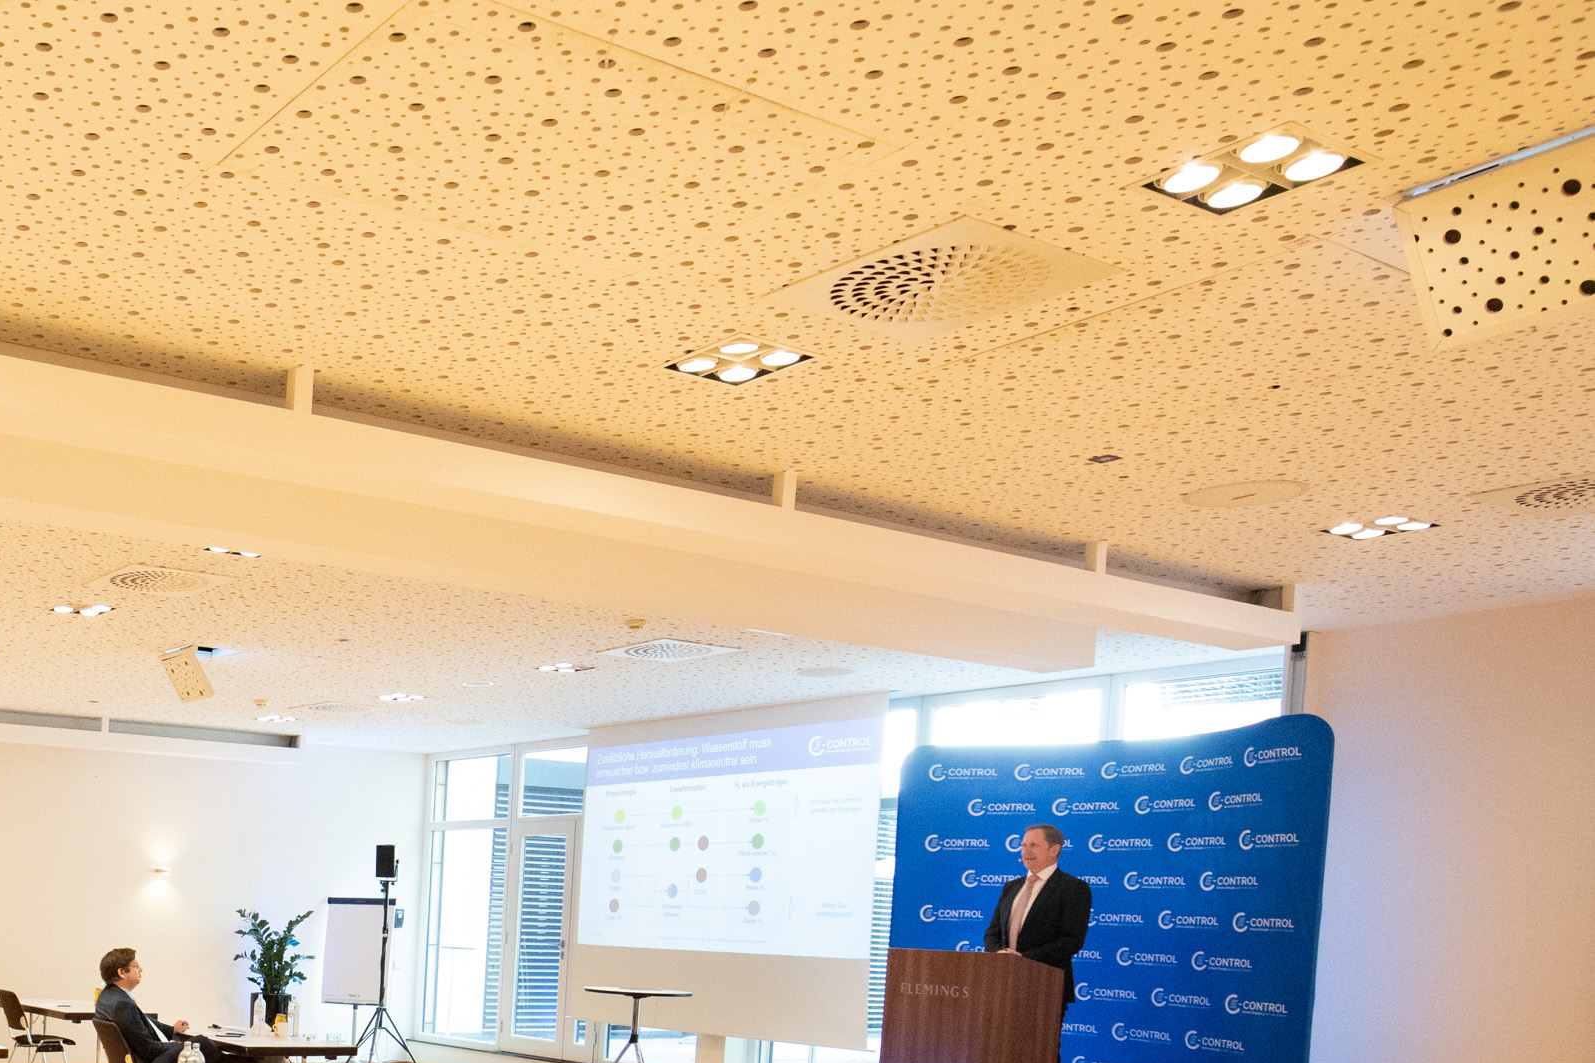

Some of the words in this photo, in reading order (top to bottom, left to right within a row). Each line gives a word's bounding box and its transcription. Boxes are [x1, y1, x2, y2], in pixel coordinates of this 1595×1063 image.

[701, 738, 748, 753] Wasserstoff
[749, 737, 772, 749] muss
[652, 759, 690, 774] zumindest
[691, 754, 739, 770] klimaneutral
[740, 753, 758, 765] sein
[900, 982, 970, 999] FLEMINGS
